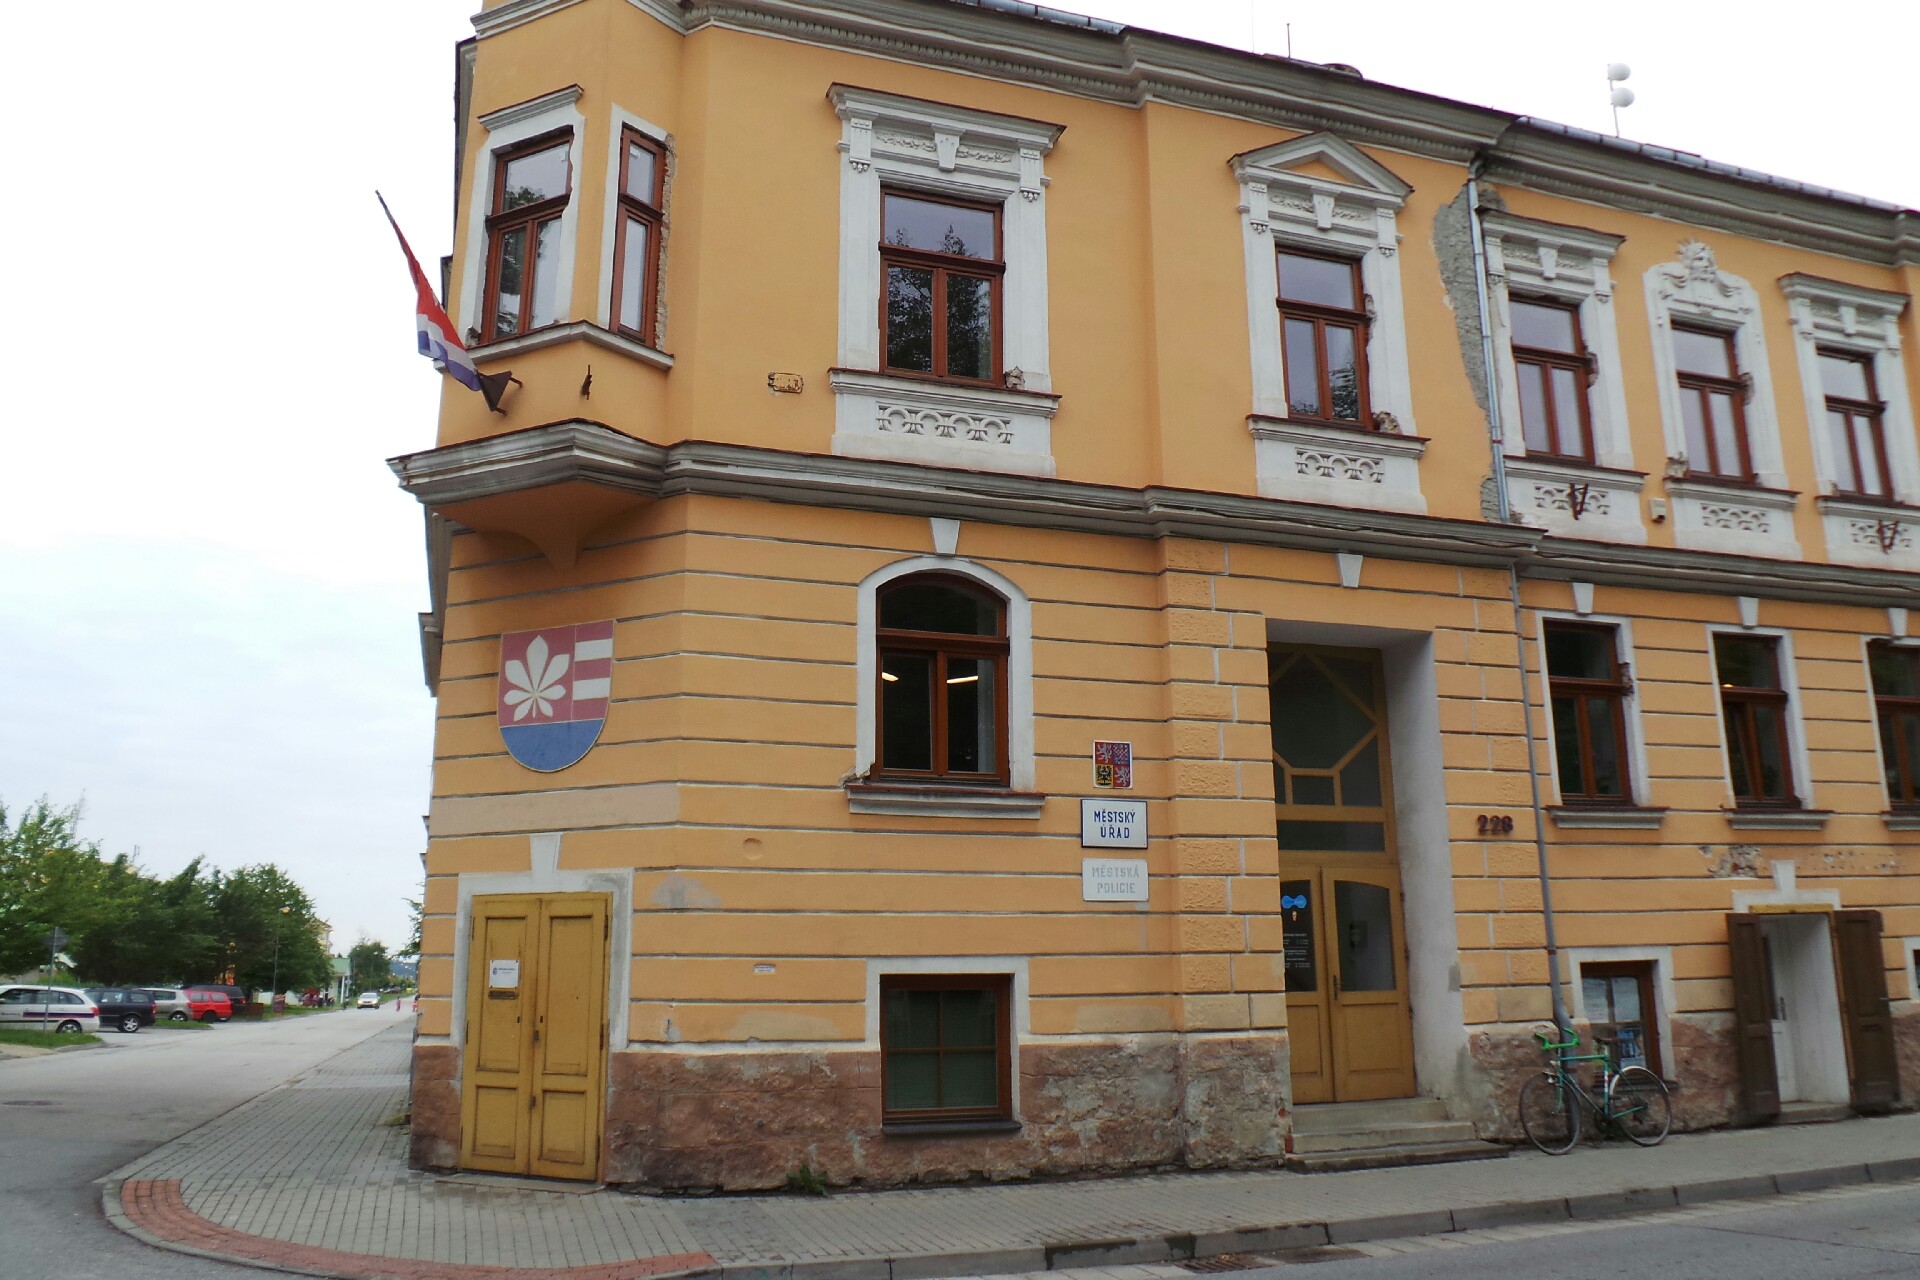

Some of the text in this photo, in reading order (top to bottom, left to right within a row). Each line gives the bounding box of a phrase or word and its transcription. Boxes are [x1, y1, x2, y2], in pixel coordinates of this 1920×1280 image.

[1093, 808, 1136, 823] MĚSTSKÝ
[1100, 824, 1130, 839] ÚŘAD
[1092, 865, 1139, 878] MĚSTSKÁ
[1097, 882, 1136, 894] POLICIE
